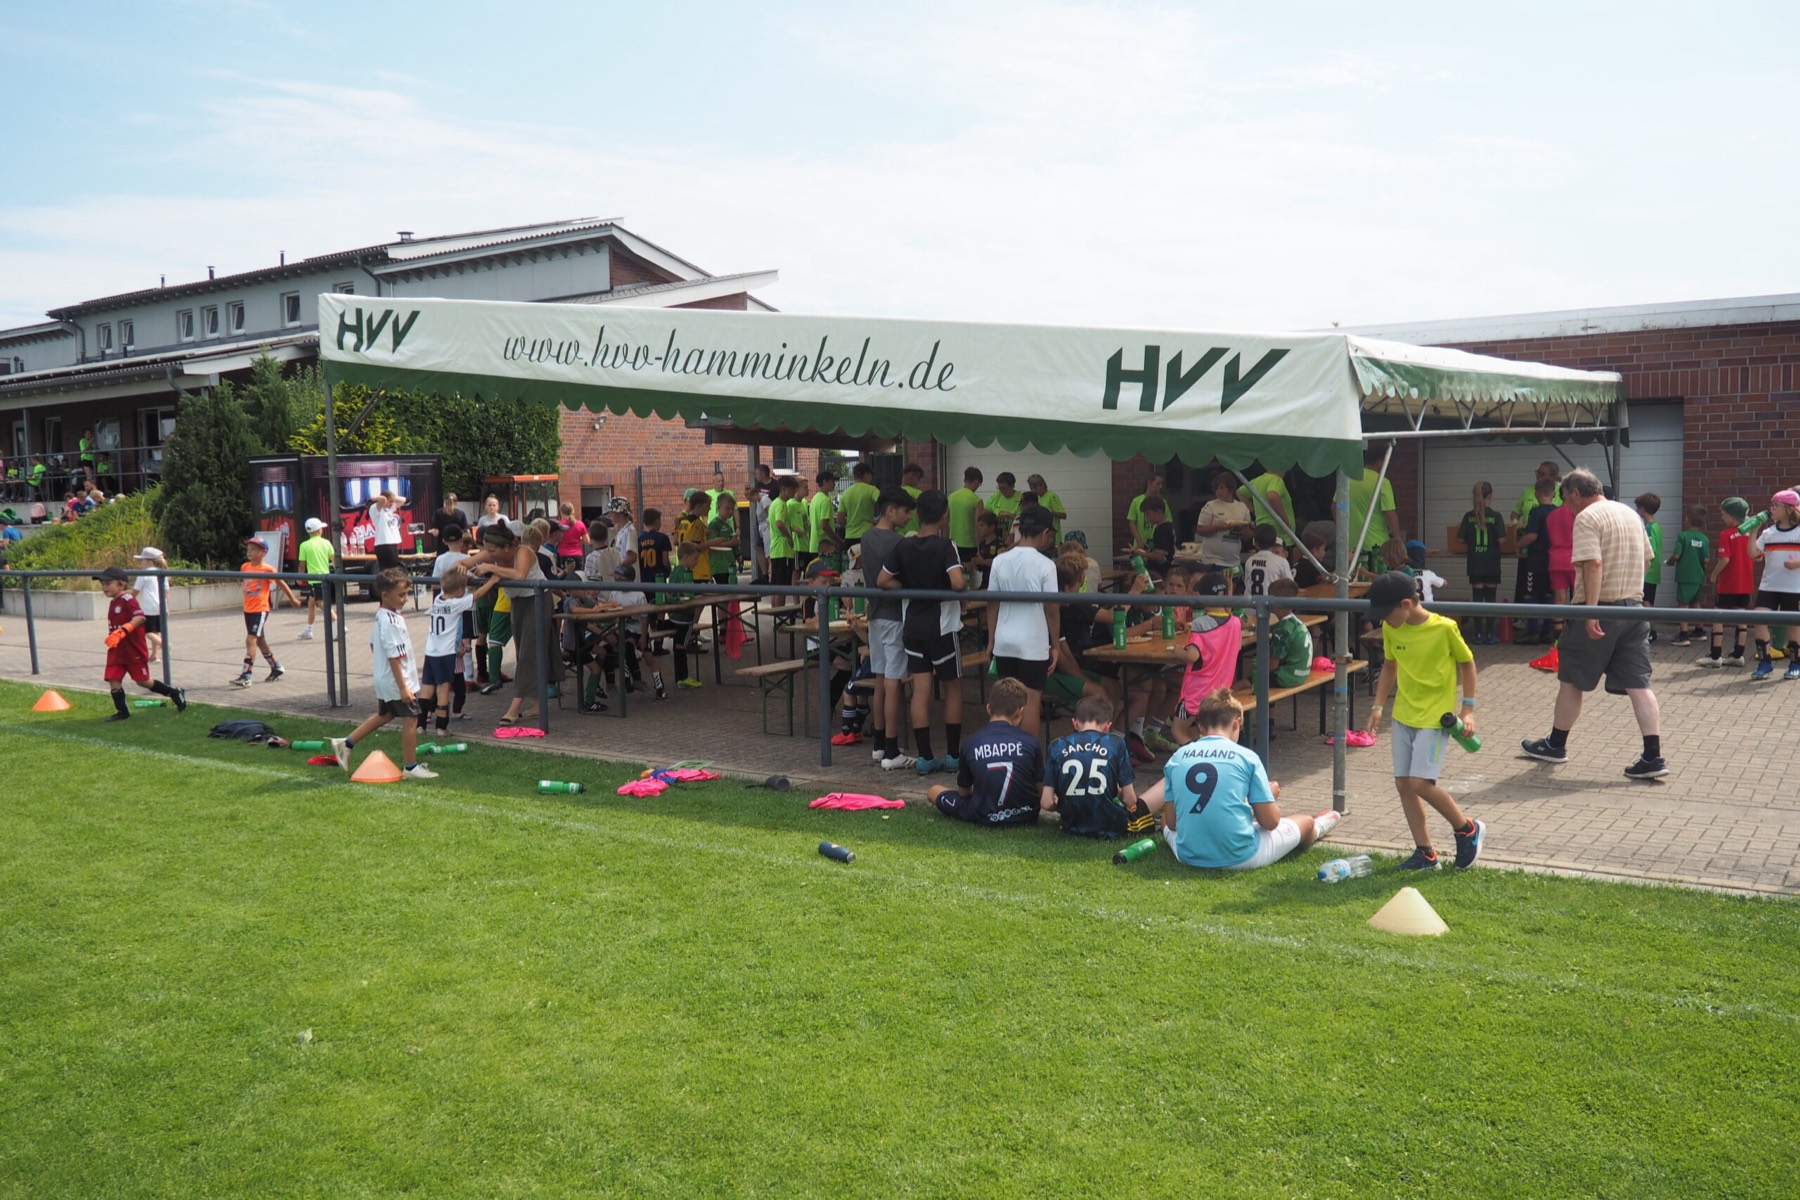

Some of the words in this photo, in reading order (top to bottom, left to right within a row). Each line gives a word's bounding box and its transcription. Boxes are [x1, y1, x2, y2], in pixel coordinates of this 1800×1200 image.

[337, 308, 421, 354] HVV
[503, 324, 957, 392] www.hvv-hamminkeln.de
[1102, 344, 1292, 414] HVV
[640, 547, 657, 569] 10
[1251, 559, 1267, 568] PHIL
[1250, 568, 1265, 596] 8
[974, 740, 1024, 761] MBAPPÉ
[1061, 742, 1109, 758] SANCHO
[1181, 748, 1236, 760] HAALAND
[986, 761, 1013, 807] 7
[1061, 758, 1109, 797] 25
[1184, 761, 1219, 814] 9
